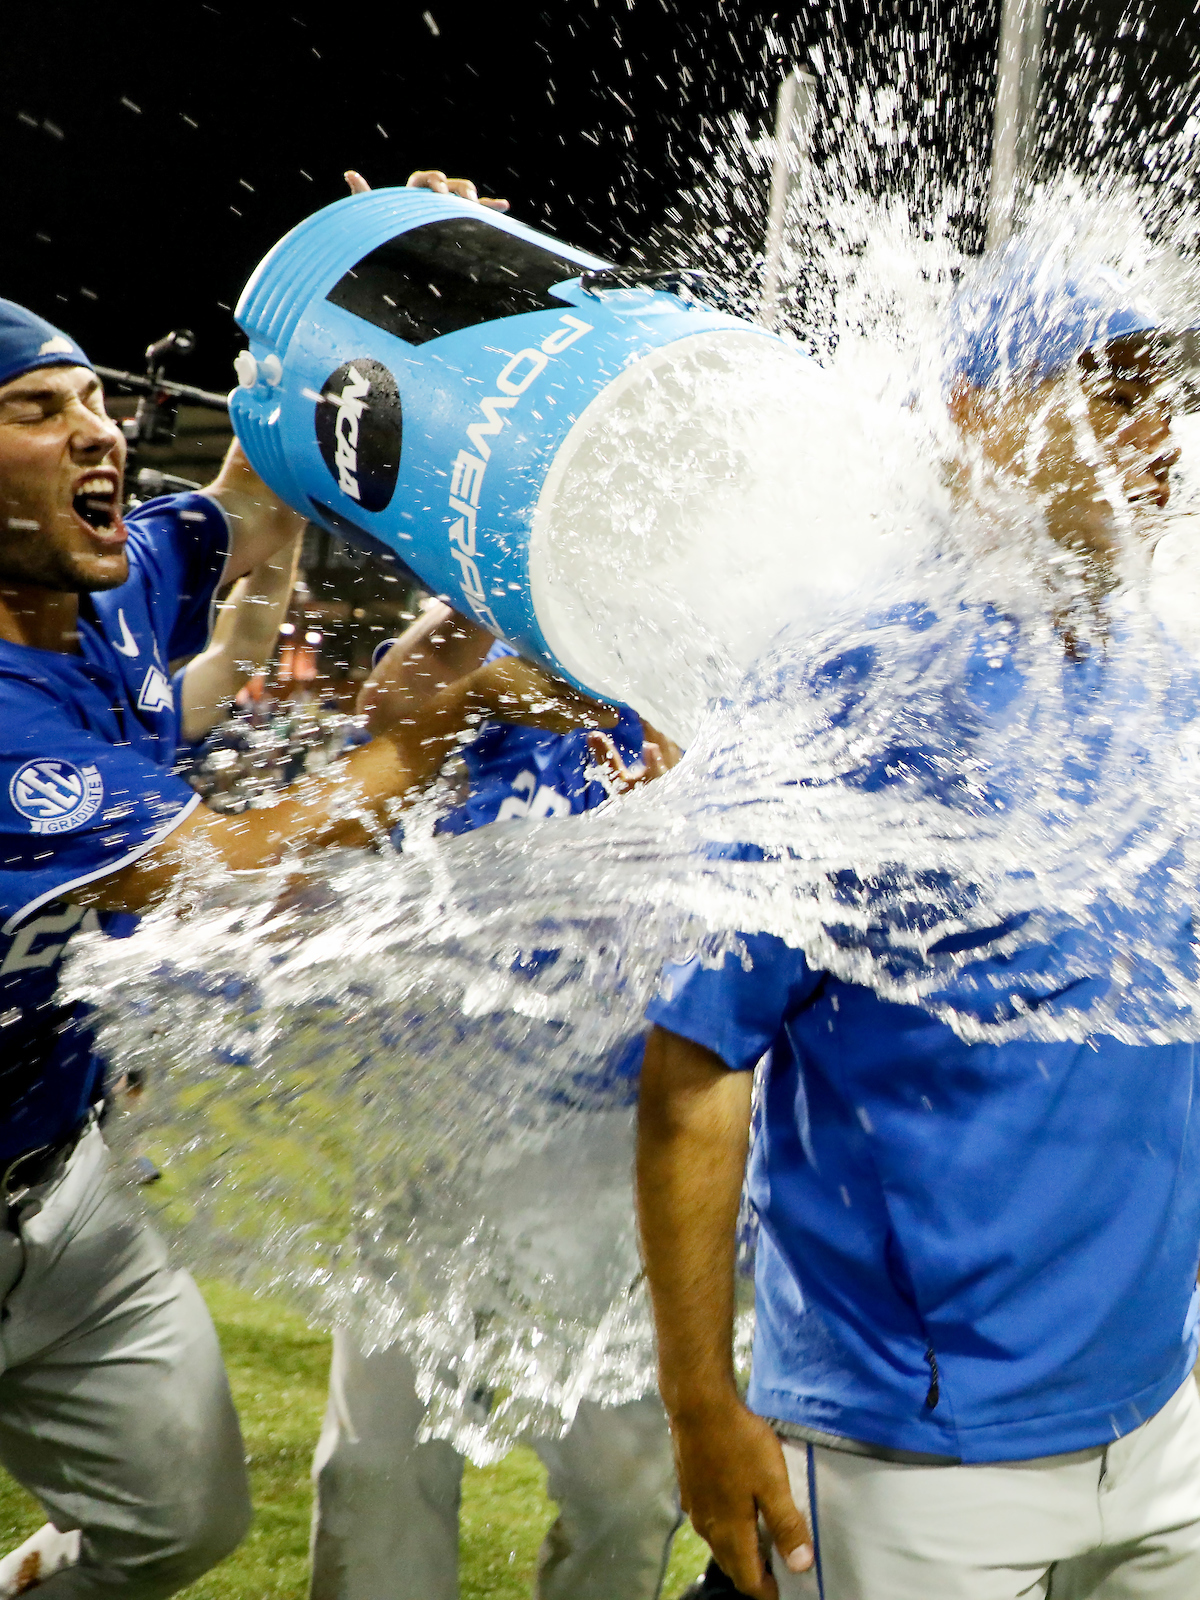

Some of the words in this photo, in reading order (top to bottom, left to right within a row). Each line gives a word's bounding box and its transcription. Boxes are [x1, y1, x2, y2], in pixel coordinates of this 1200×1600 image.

[334, 365, 371, 501] NCAA
[449, 314, 594, 640] POWERAD
[16, 763, 81, 817] SEC
[47, 781, 102, 832] GRADUATE
